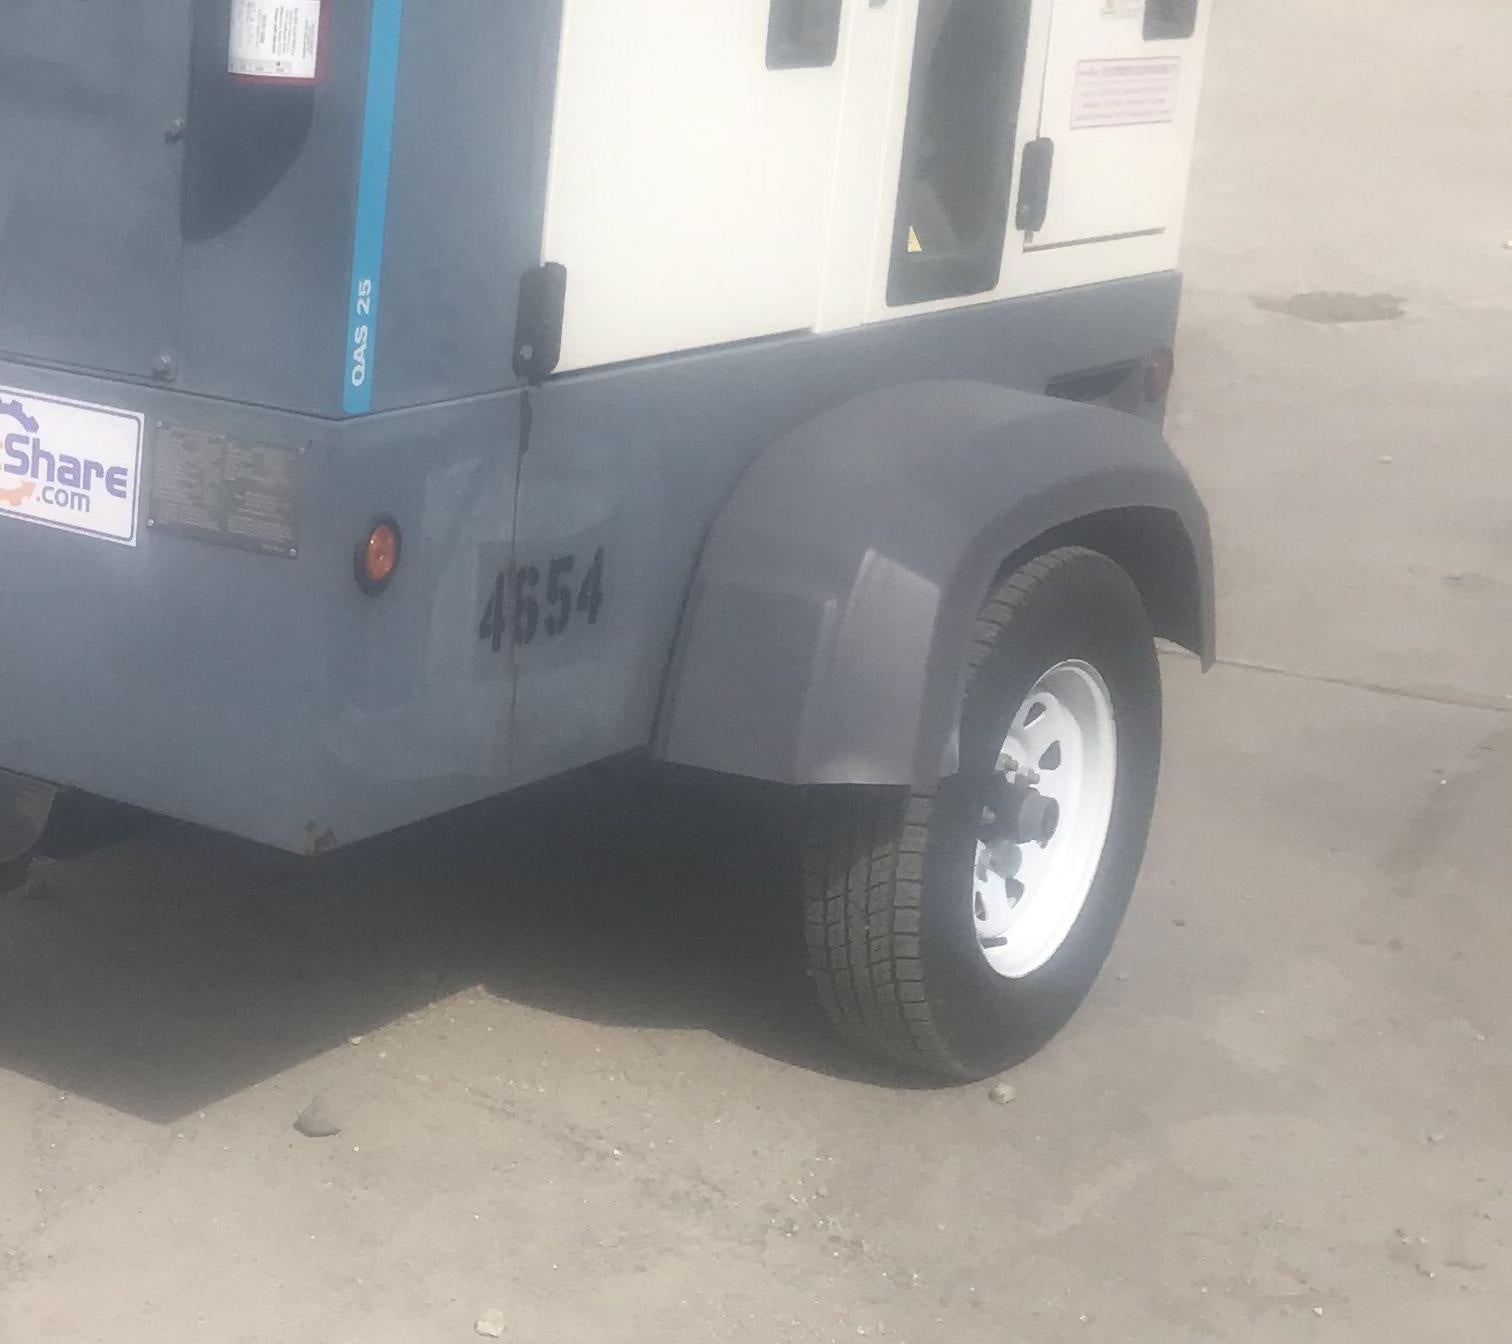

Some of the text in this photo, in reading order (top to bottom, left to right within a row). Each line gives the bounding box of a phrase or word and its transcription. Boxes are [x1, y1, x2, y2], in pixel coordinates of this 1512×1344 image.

[356, 279, 372, 315] 25
[35, 485, 91, 513] .com
[479, 546, 605, 652] 4654
